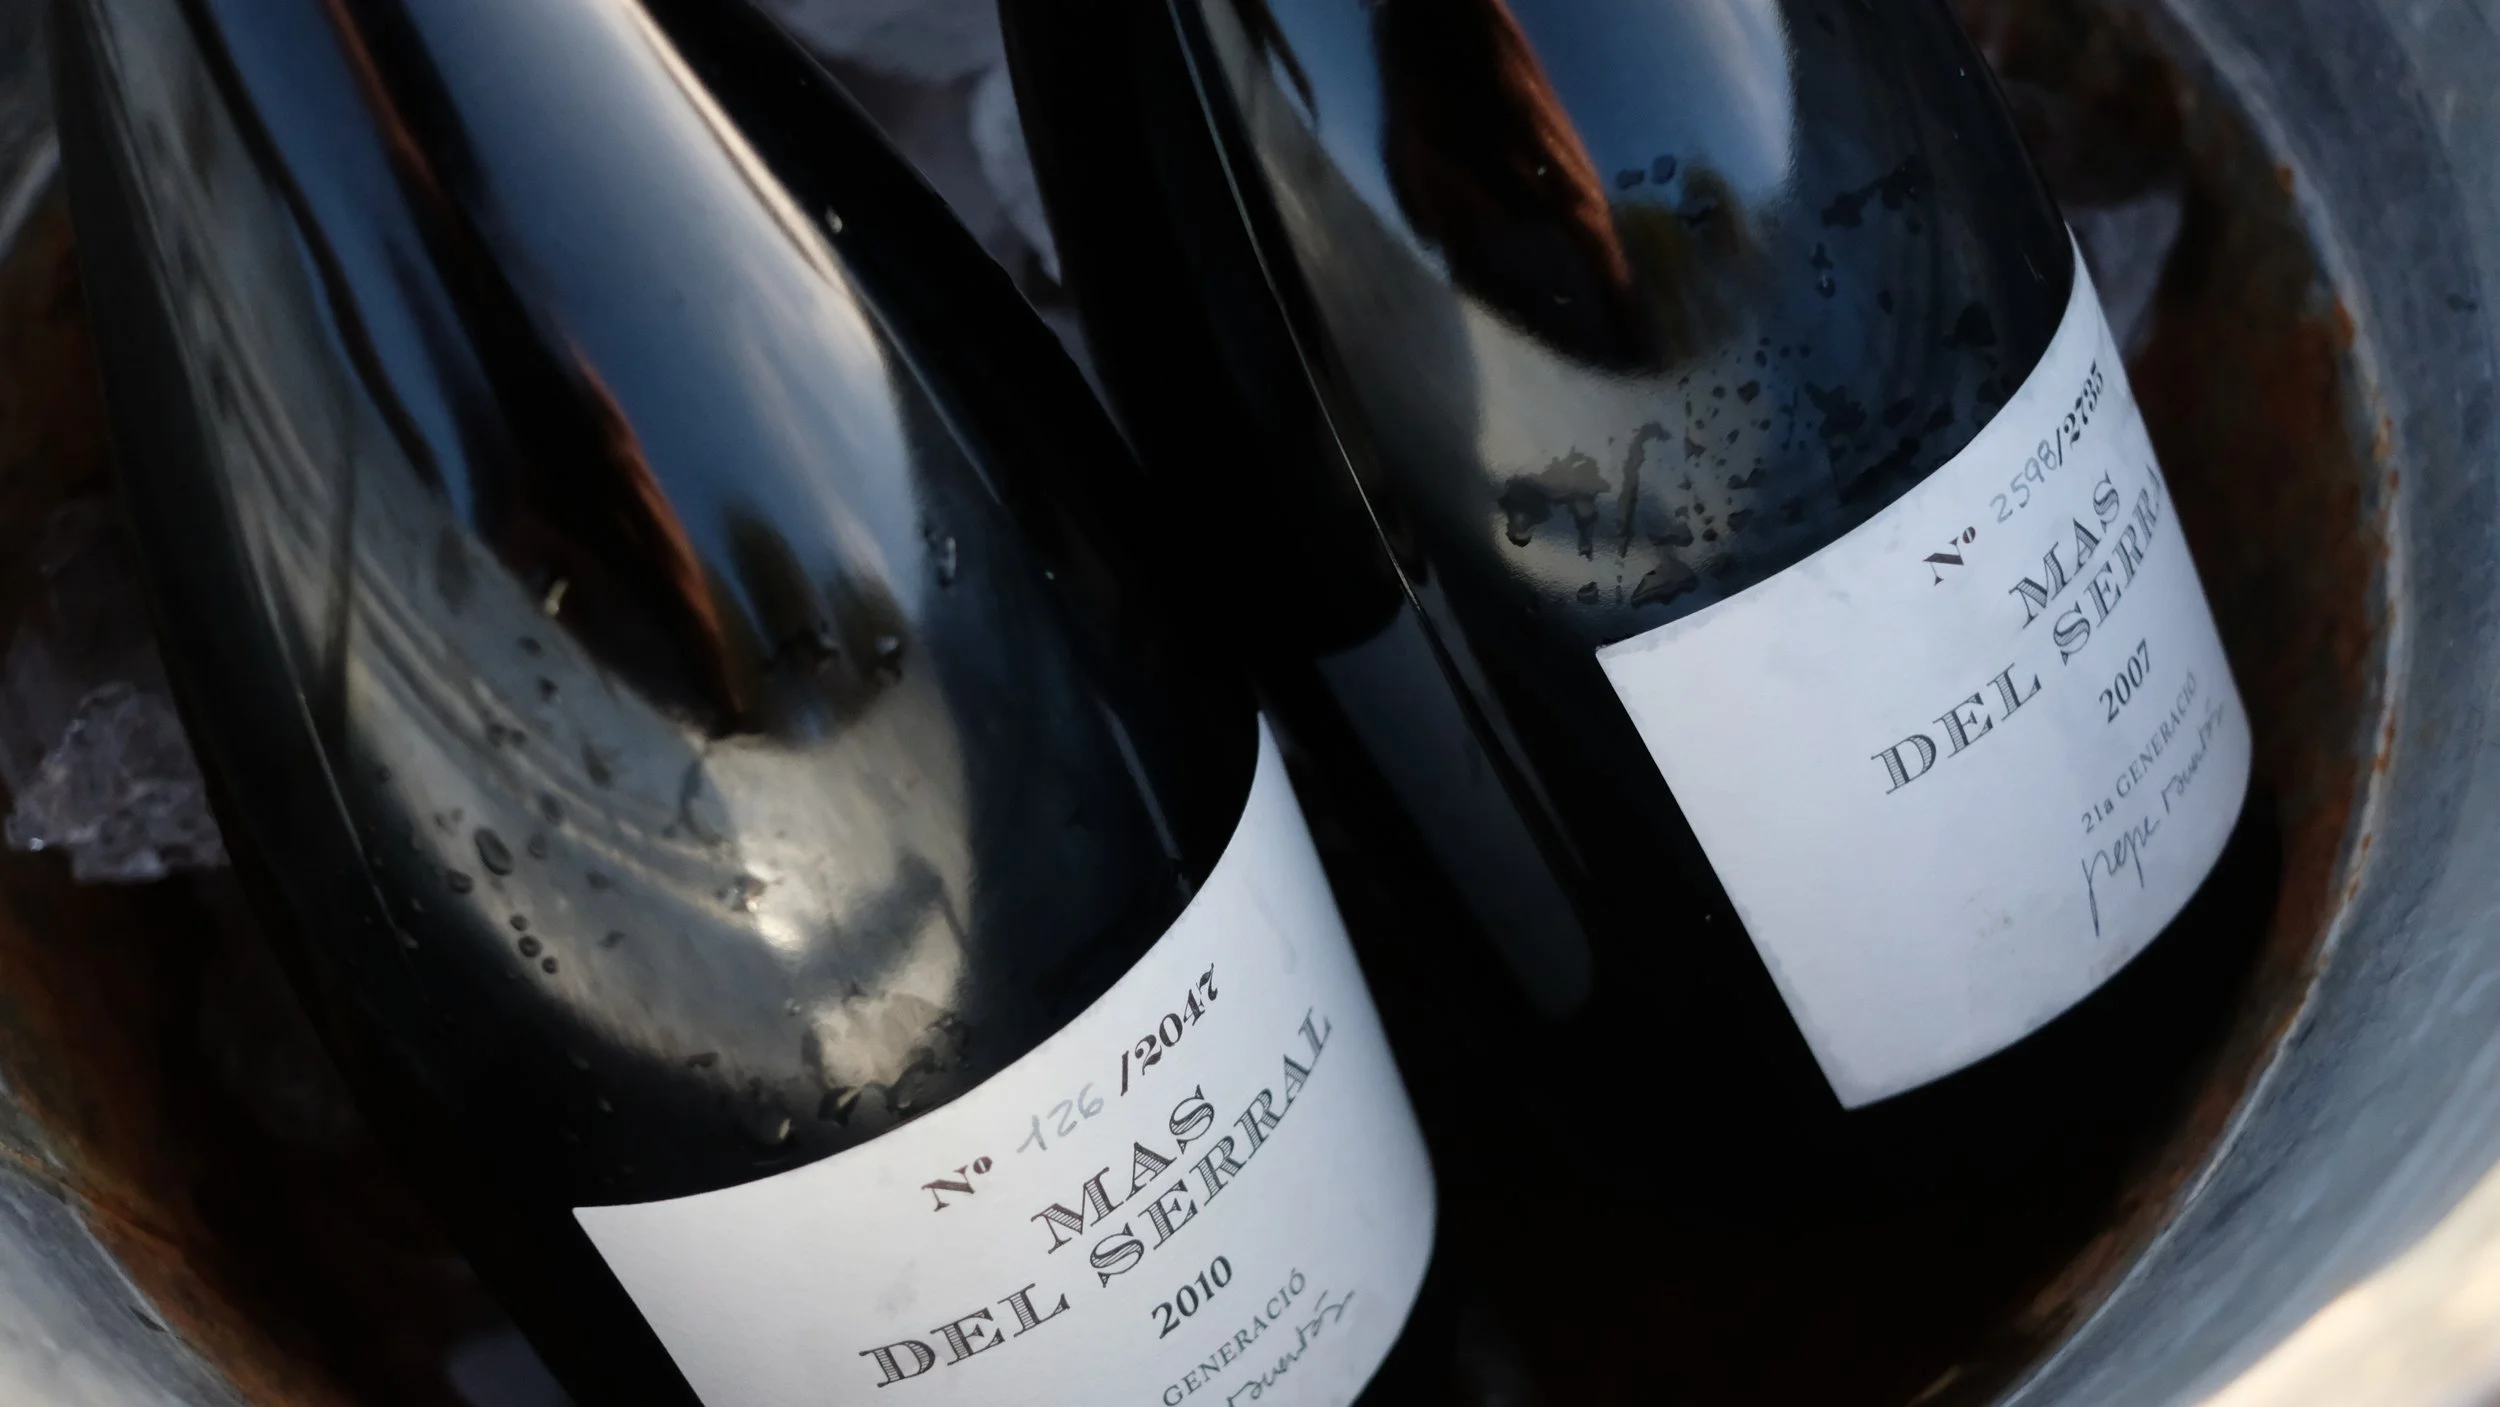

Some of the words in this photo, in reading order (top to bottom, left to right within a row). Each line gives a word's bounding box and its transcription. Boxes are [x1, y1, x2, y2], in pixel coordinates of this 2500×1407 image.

[2008, 468, 2120, 629] MAS
[1870, 662, 2042, 795] DEL
[2098, 638, 2151, 724] 2007
[2081, 798, 2114, 834] 21a
[1015, 1081, 1105, 1155] 126
[1030, 1084, 1215, 1255] MAS
[859, 1282, 1071, 1388] DEL
[1089, 1006, 1333, 1288] SERRAL
[1151, 1255, 1233, 1340] 2010
[1162, 1267, 1306, 1407] GENERACIÓ
